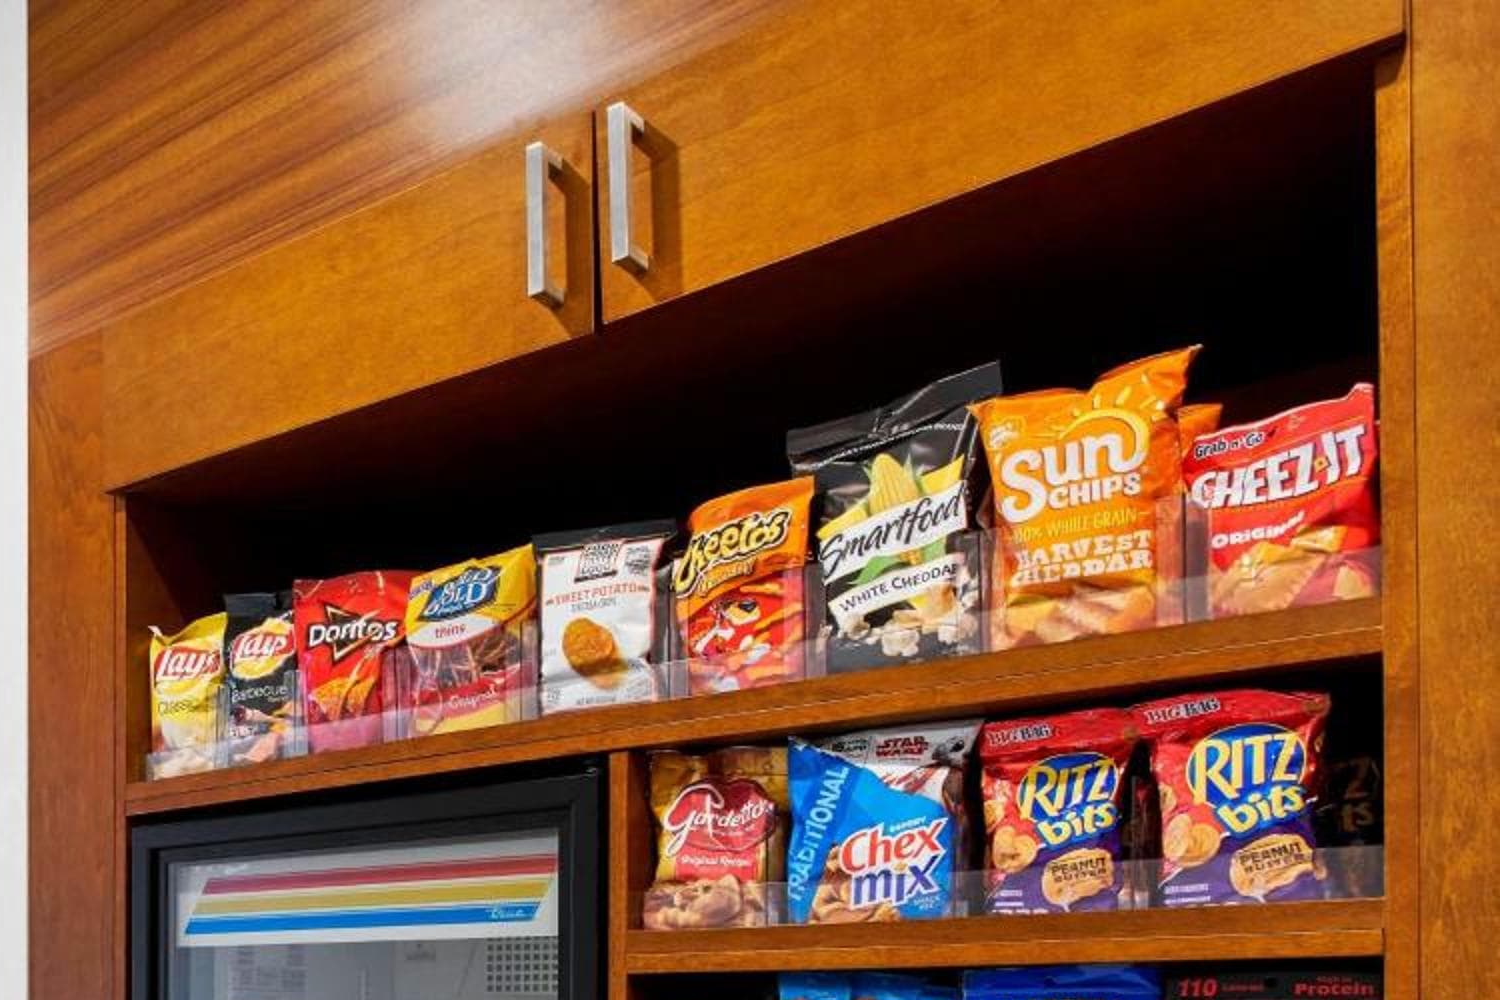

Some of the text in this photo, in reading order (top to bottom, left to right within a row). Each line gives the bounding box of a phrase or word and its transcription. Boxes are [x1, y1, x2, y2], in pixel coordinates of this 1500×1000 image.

[1194, 440, 1228, 459] Grab
[1244, 431, 1265, 448] Go
[1000, 428, 1148, 524] Sun
[1047, 471, 1142, 510] CHIPS
[674, 509, 791, 597] Cheetos
[819, 487, 966, 582] Smartfood
[840, 582, 889, 612] WHITE
[308, 617, 397, 646] Doritos
[1020, 757, 1117, 819] RITZ
[1191, 732, 1300, 807] RITZ
[788, 766, 850, 900] TRADITIONAL
[1037, 801, 1118, 845] bits
[1217, 783, 1307, 834] bits
[840, 818, 949, 874] Chex
[1050, 856, 1108, 876] PEANUT
[1238, 841, 1303, 866] PEANUT
[852, 856, 938, 907] mix
[1178, 976, 1218, 998] 110
